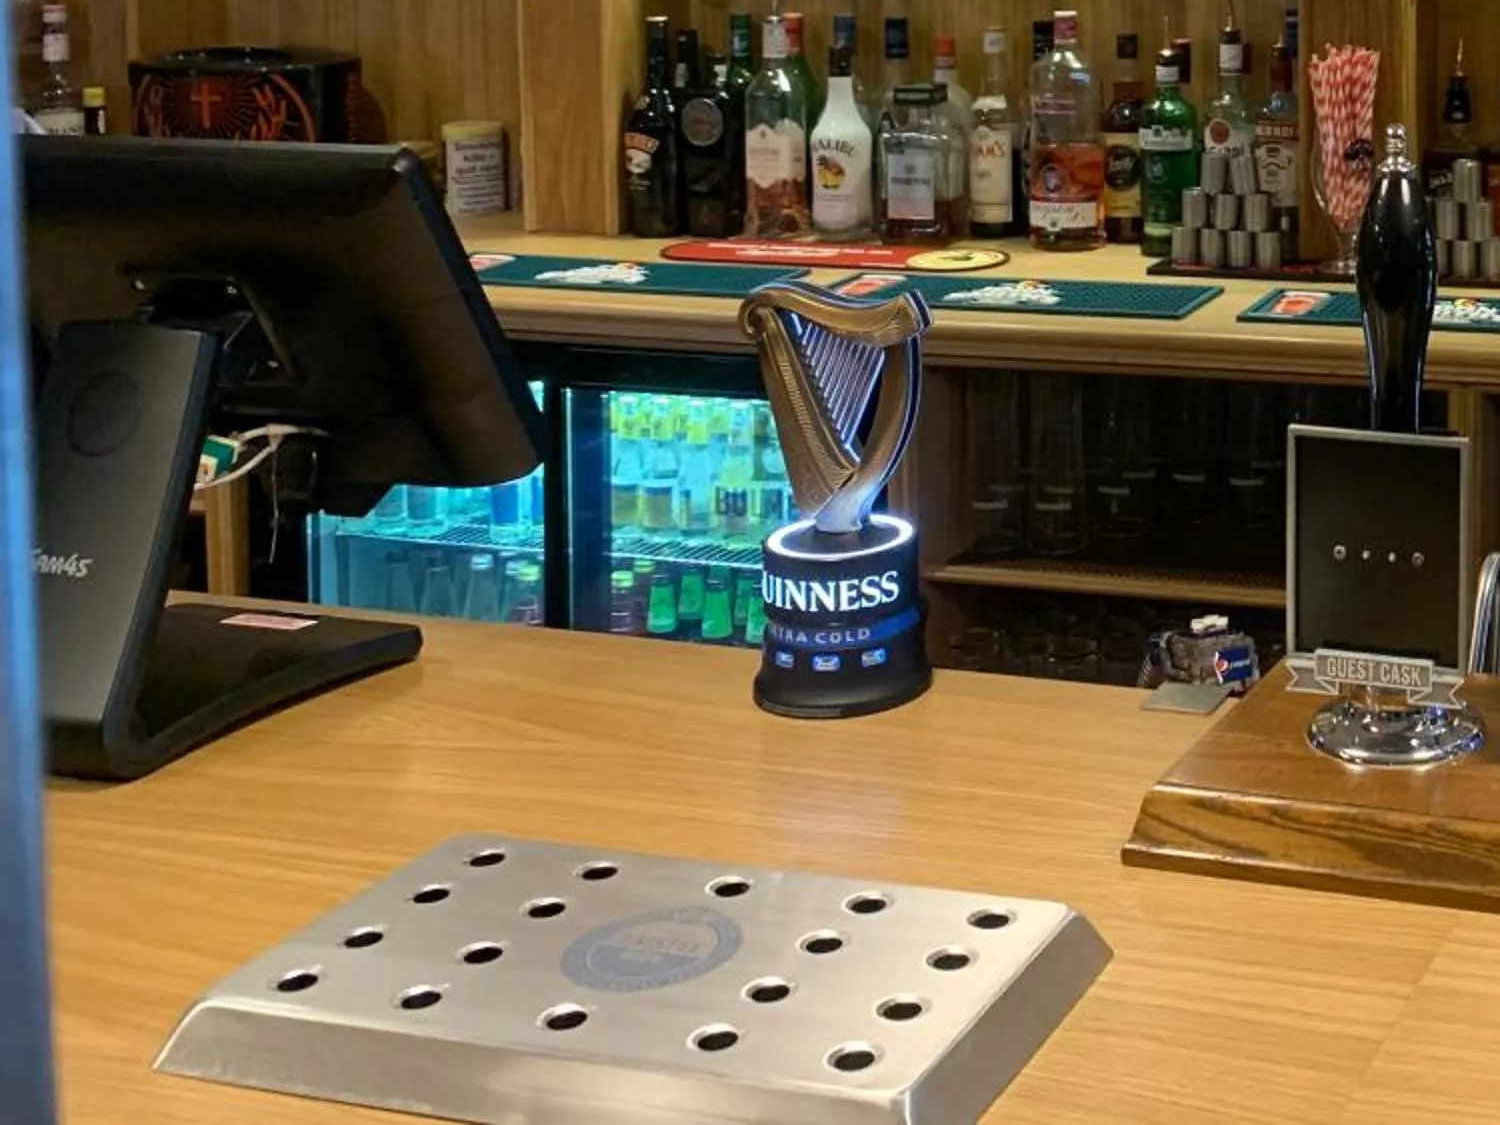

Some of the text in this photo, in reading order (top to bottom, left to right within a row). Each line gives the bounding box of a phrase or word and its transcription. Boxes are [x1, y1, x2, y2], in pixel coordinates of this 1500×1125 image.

[761, 570, 900, 613] UINNESS
[815, 627, 871, 645] COLD
[1327, 658, 1421, 686] GUEST CASK
